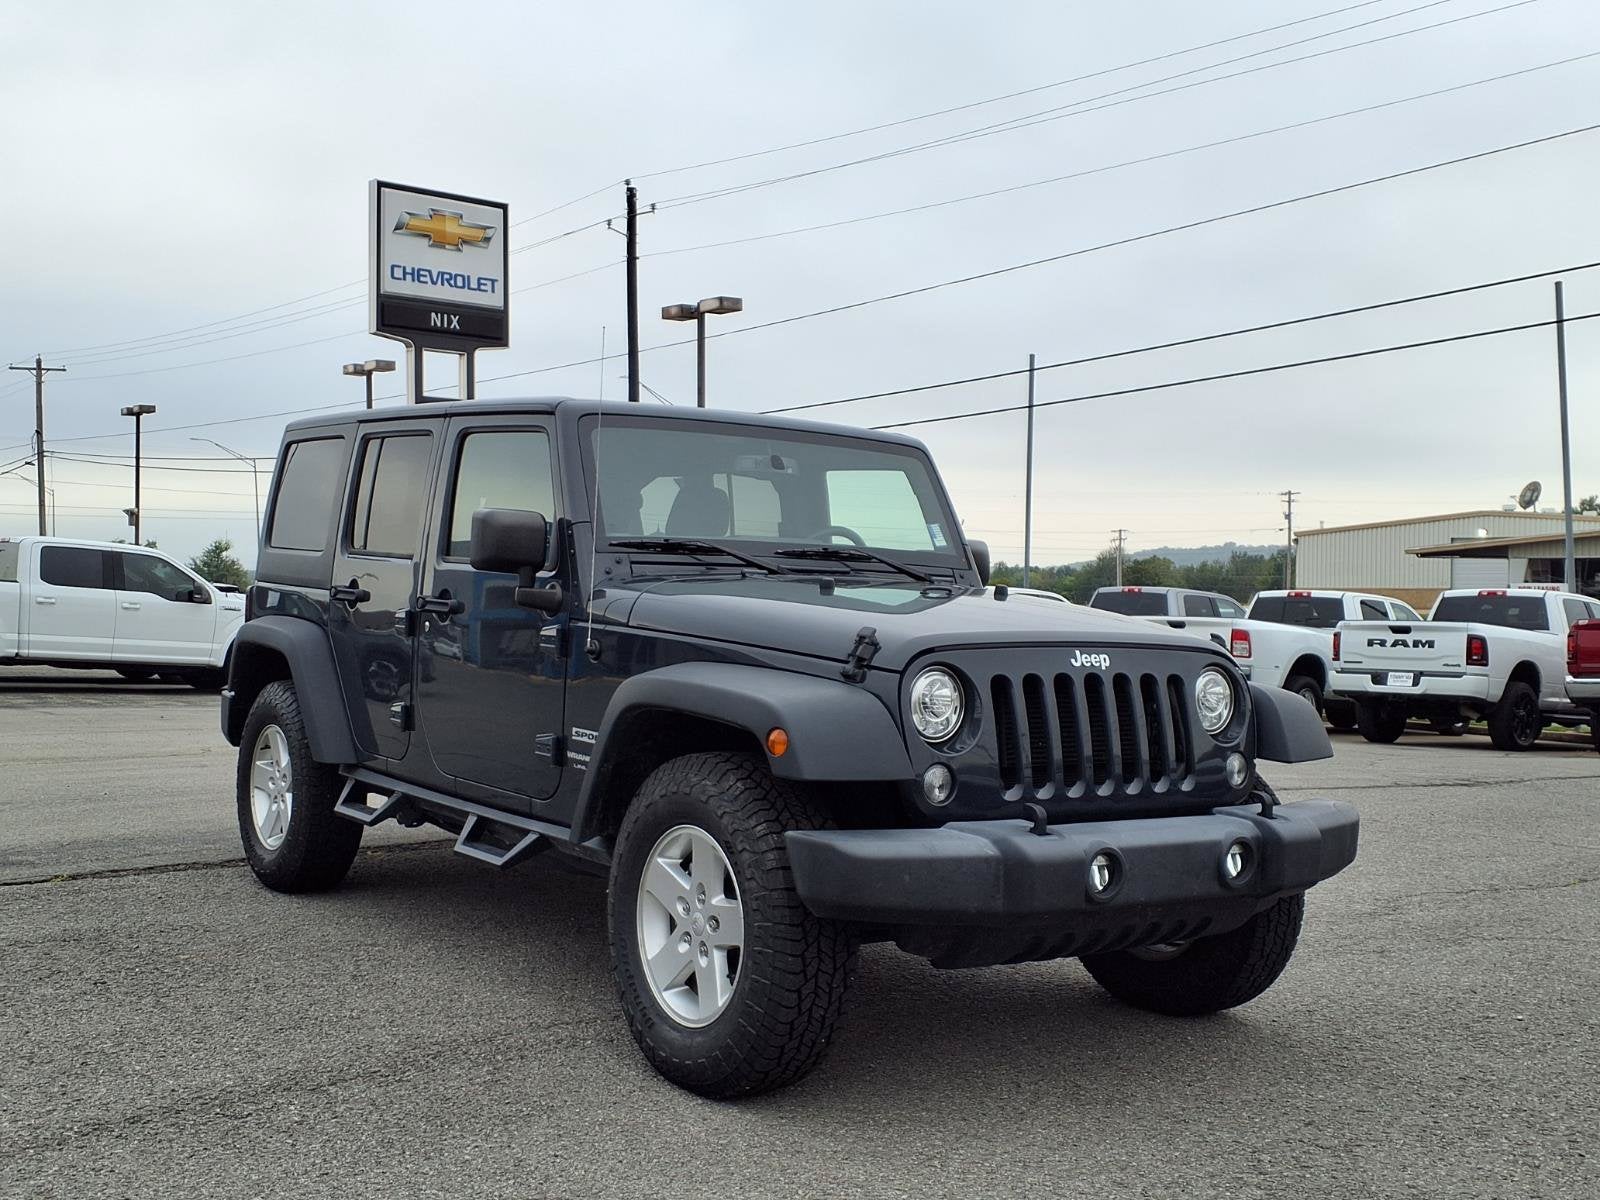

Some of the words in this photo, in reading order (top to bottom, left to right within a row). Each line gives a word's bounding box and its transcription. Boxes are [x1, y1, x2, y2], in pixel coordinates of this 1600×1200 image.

[390, 264, 498, 294] CHEVROLET
[431, 312, 460, 330] NIX
[1367, 638, 1435, 649] RAM
[1070, 649, 1111, 670] Jeep
